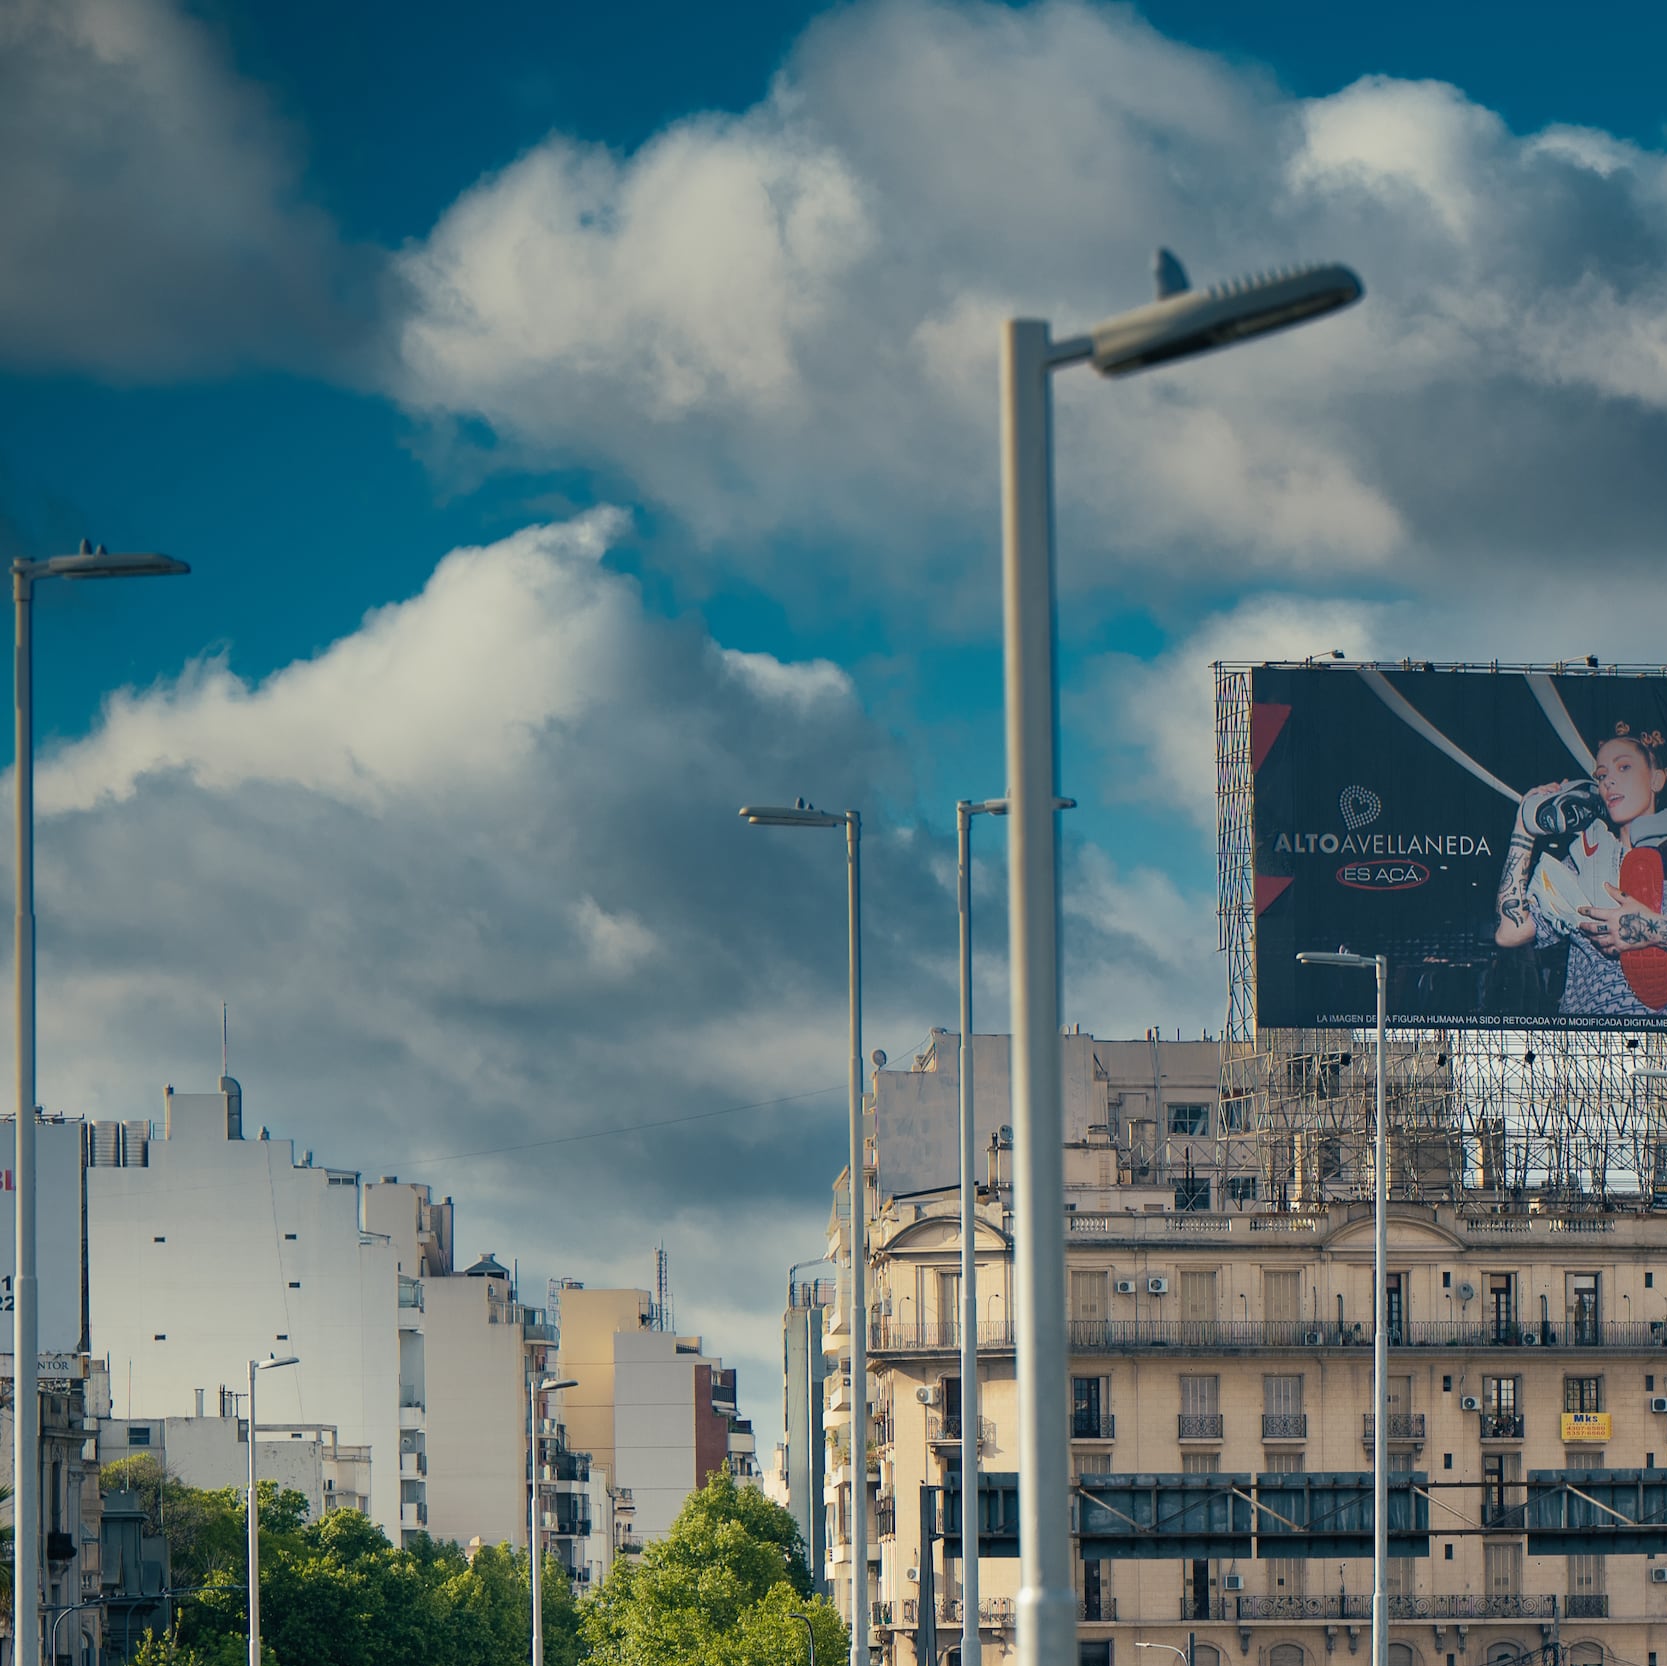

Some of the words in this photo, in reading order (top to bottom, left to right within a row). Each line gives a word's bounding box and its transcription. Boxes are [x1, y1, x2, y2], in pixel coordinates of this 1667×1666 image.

[1344, 867, 1370, 882] ES
[1316, 1014, 1328, 1023] LA
[1329, 1014, 1361, 1023] IMAGEN
[1365, 1014, 1376, 1024] DE
[1392, 1015, 1425, 1024] FIGURA
[1426, 1015, 1464, 1024] HUMANA
[1465, 1015, 1478, 1024] HA
[1479, 1016, 1501, 1025] SIDO
[1502, 1016, 1550, 1025] RETOCADA
[1551, 1017, 1567, 1026] Y/O
[1568, 1017, 1623, 1027] MODIFICADA
